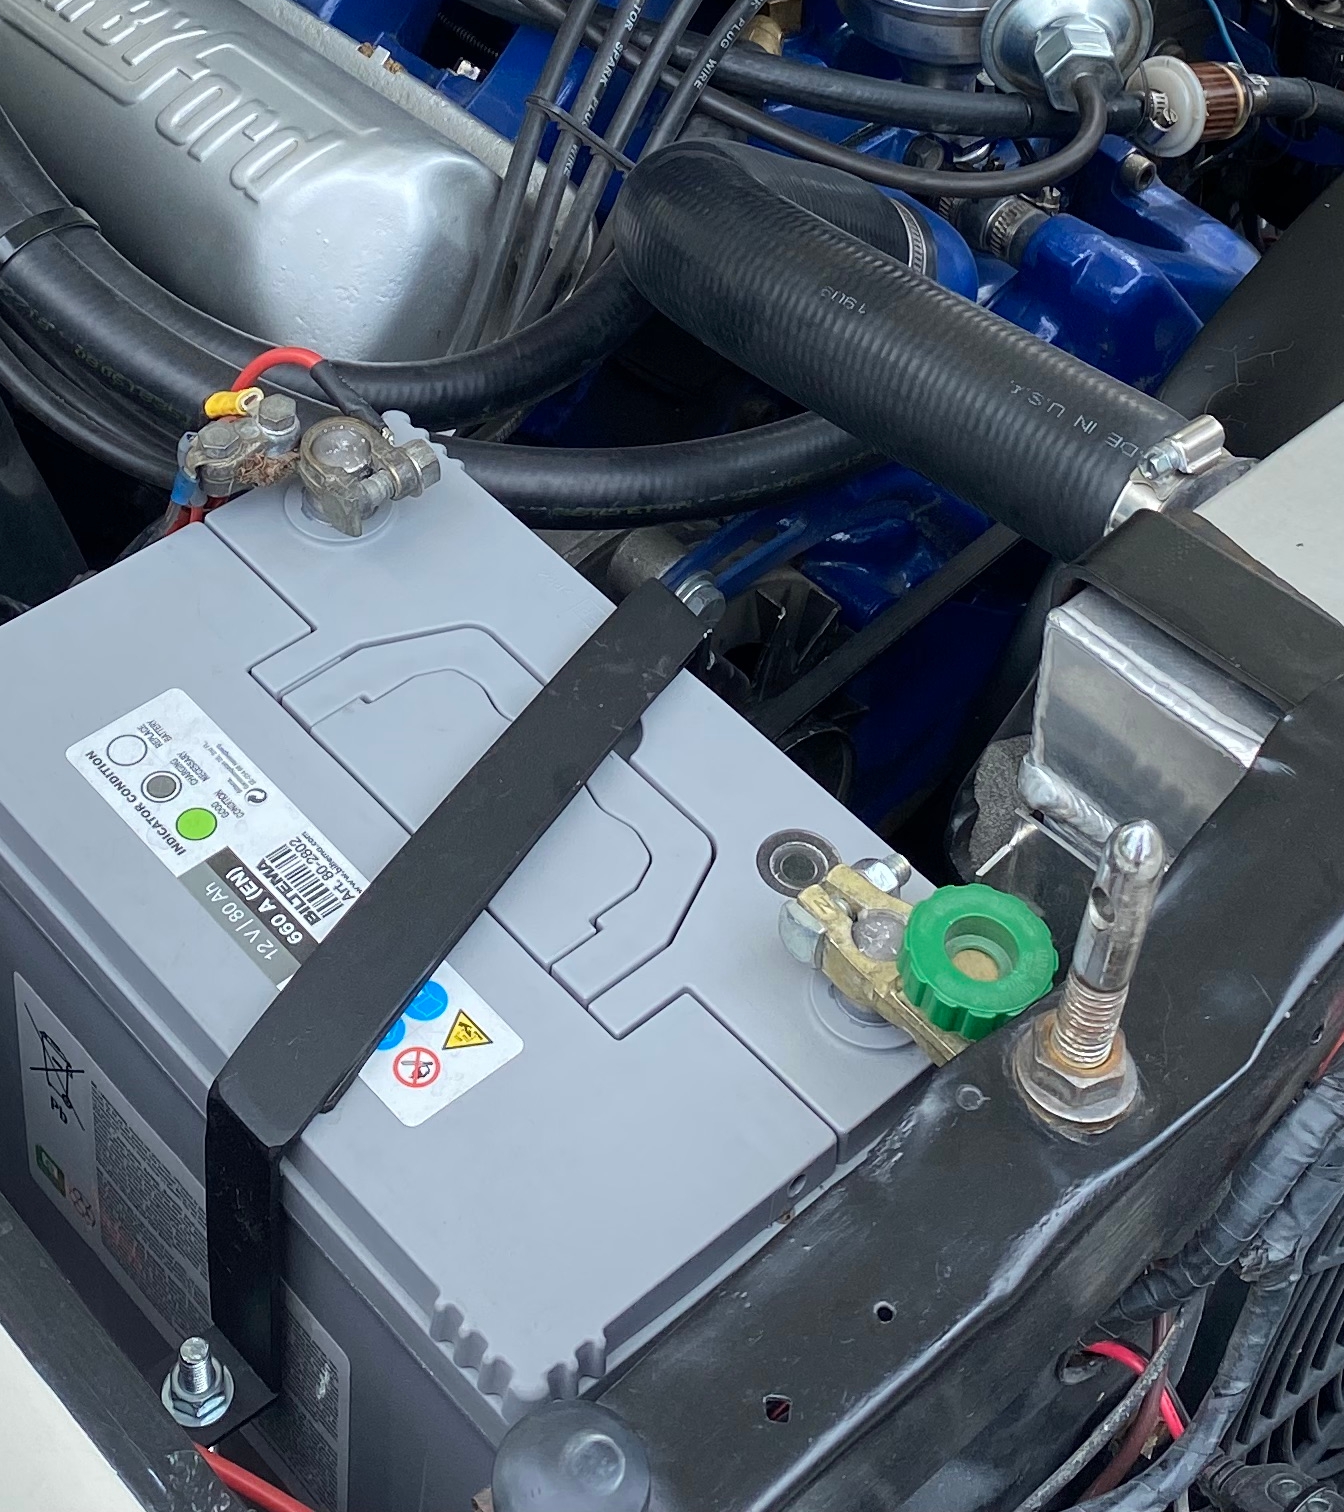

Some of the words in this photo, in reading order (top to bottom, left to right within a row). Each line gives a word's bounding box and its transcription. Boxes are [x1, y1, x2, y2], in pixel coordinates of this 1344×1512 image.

[719, 17, 745, 50] PLUG
[597, 40, 625, 88] SPARK
[693, 58, 718, 90] WIRE
[1073, 413, 1098, 435] IN
[136, 722, 164, 748] REPLACE
[145, 717, 173, 743] BATTERY
[83, 748, 138, 804] CONDITION
[169, 756, 200, 786] CHARGING
[209, 800, 230, 819] GOOD
[132, 801, 186, 856] INDICATOR
[288, 835, 334, 882] 80-2802
[201, 880, 228, 905] Ah
[223, 863, 264, 902] (EN)
[254, 857, 321, 926] BILTEMA
[329, 879, 355, 903] Art.
[219, 899, 245, 923] 80
[255, 897, 276, 915] A
[813, 896, 834, 916] N
[242, 923, 263, 943] V
[268, 911, 304, 945] 660
[255, 937, 280, 960] 12
[49, 1095, 69, 1125] Pb
